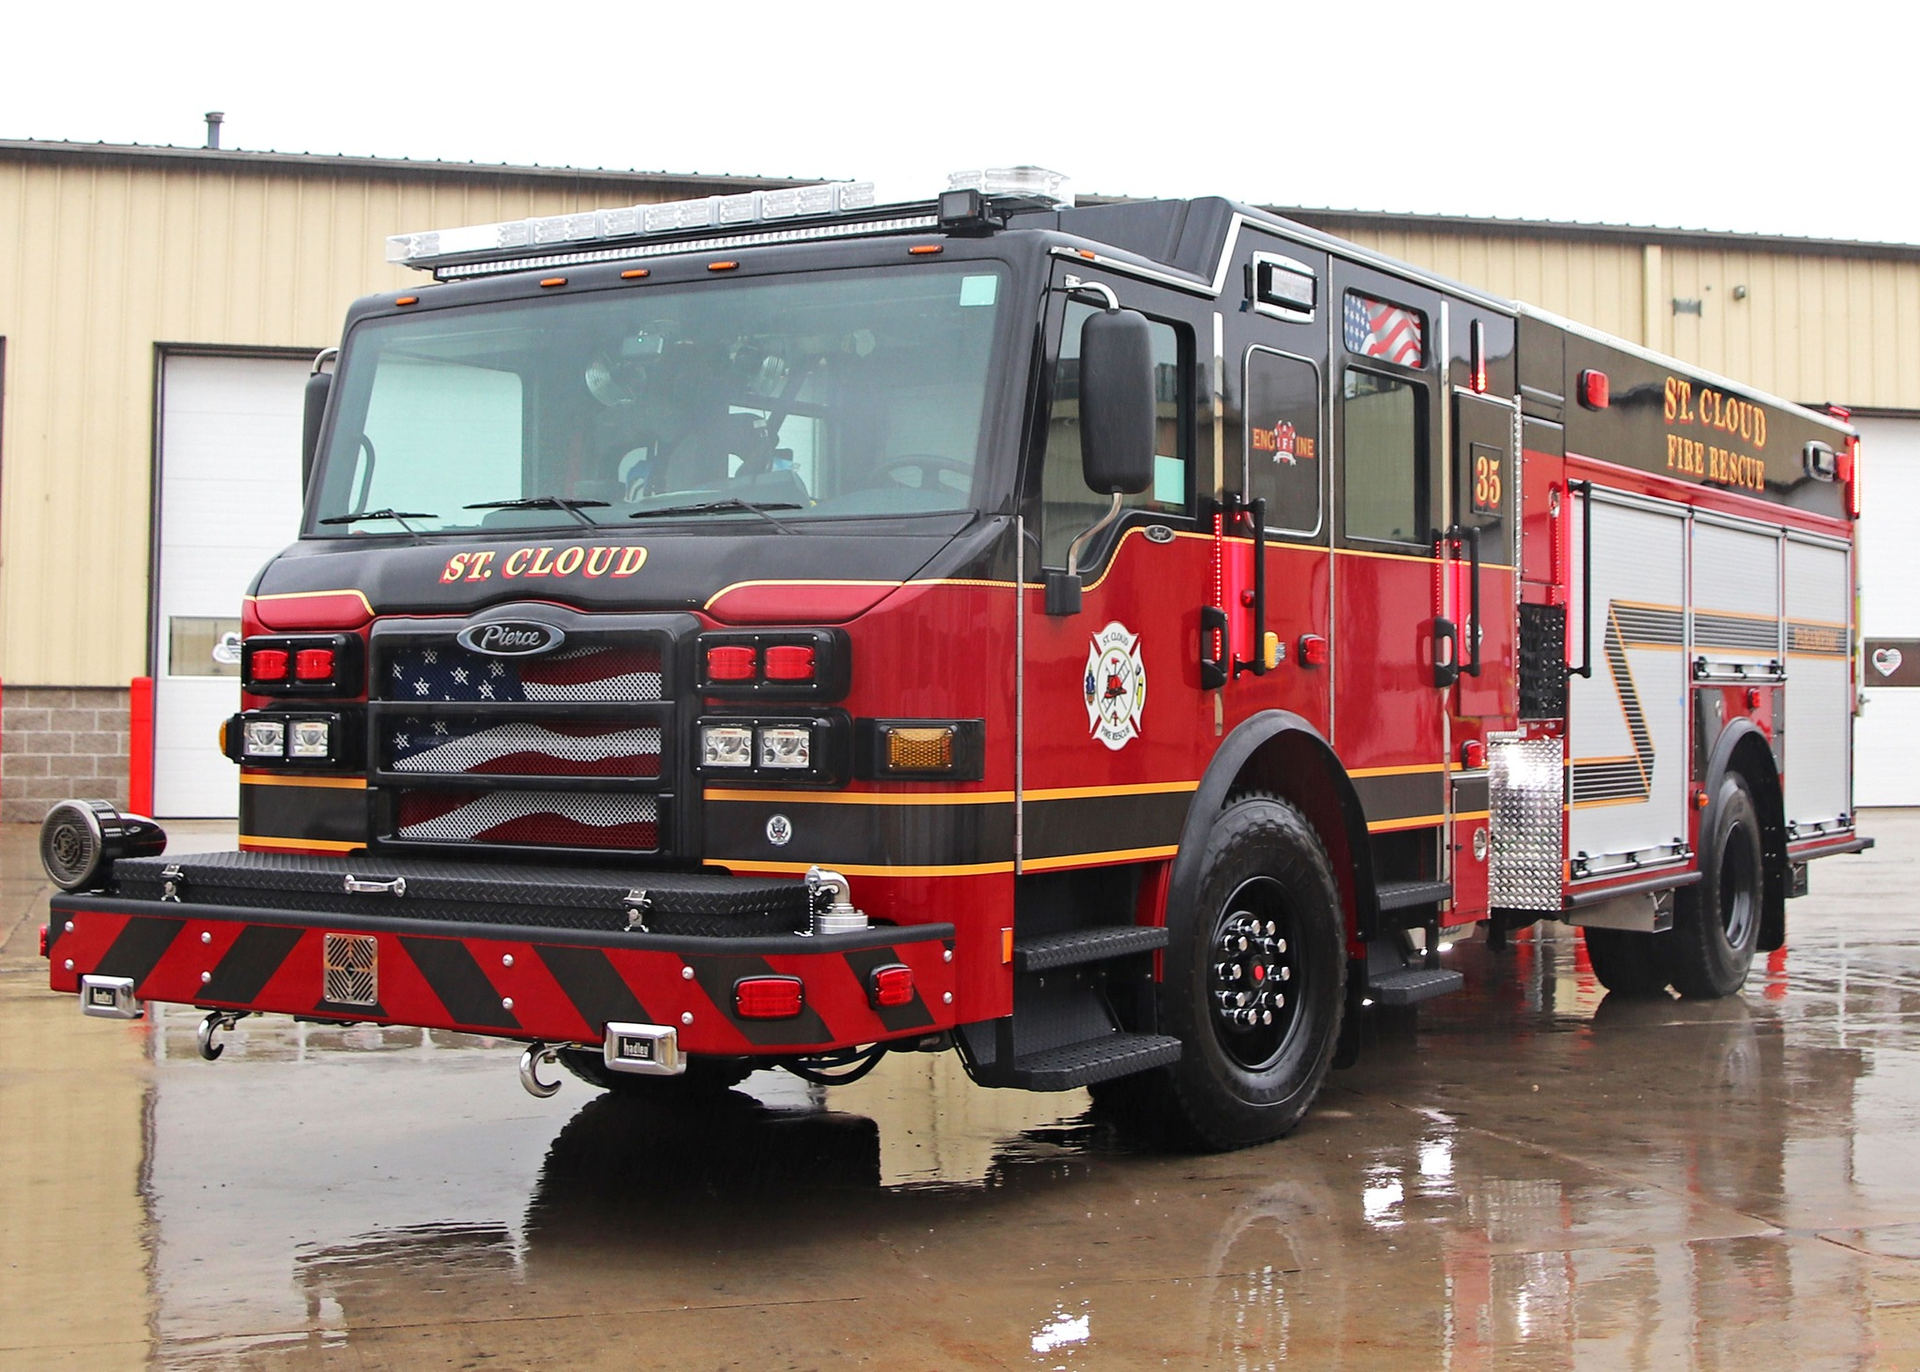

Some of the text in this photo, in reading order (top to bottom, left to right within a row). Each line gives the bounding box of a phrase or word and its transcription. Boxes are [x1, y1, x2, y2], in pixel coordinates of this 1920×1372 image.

[1664, 376, 1766, 450] ST. CLOUD
[1476, 455, 1502, 509] 35
[1667, 433, 1765, 493] FIRE RESCUE
[438, 546, 648, 584] ST. CLOUD
[480, 625, 541, 649] Pierce
